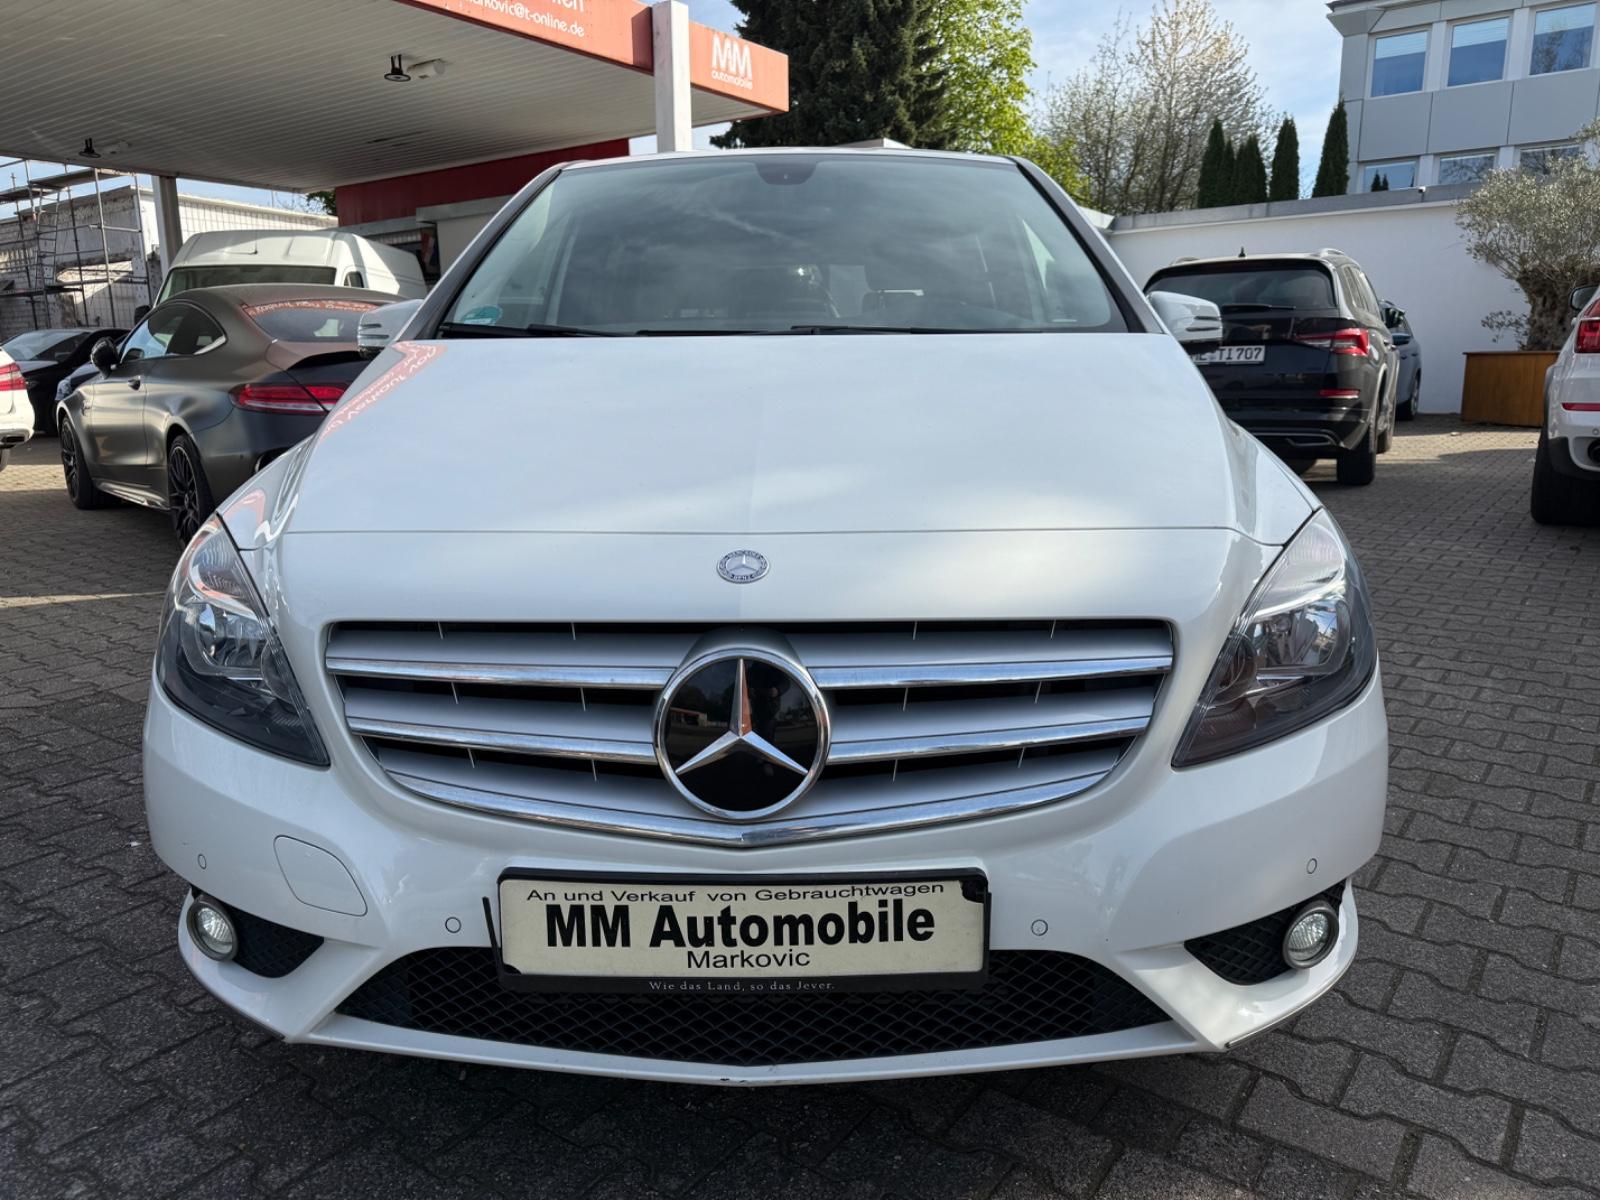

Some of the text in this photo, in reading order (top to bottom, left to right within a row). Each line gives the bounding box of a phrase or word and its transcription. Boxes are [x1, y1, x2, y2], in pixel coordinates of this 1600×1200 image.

[712, 33, 752, 79] MM
[527, 884, 945, 902] An und Verkauf von Gebrauchtwagen
[546, 898, 935, 948] MM Automobile
[687, 949, 811, 969] Markovic
[649, 980, 836, 992] Wie das Land, so das Jever.
